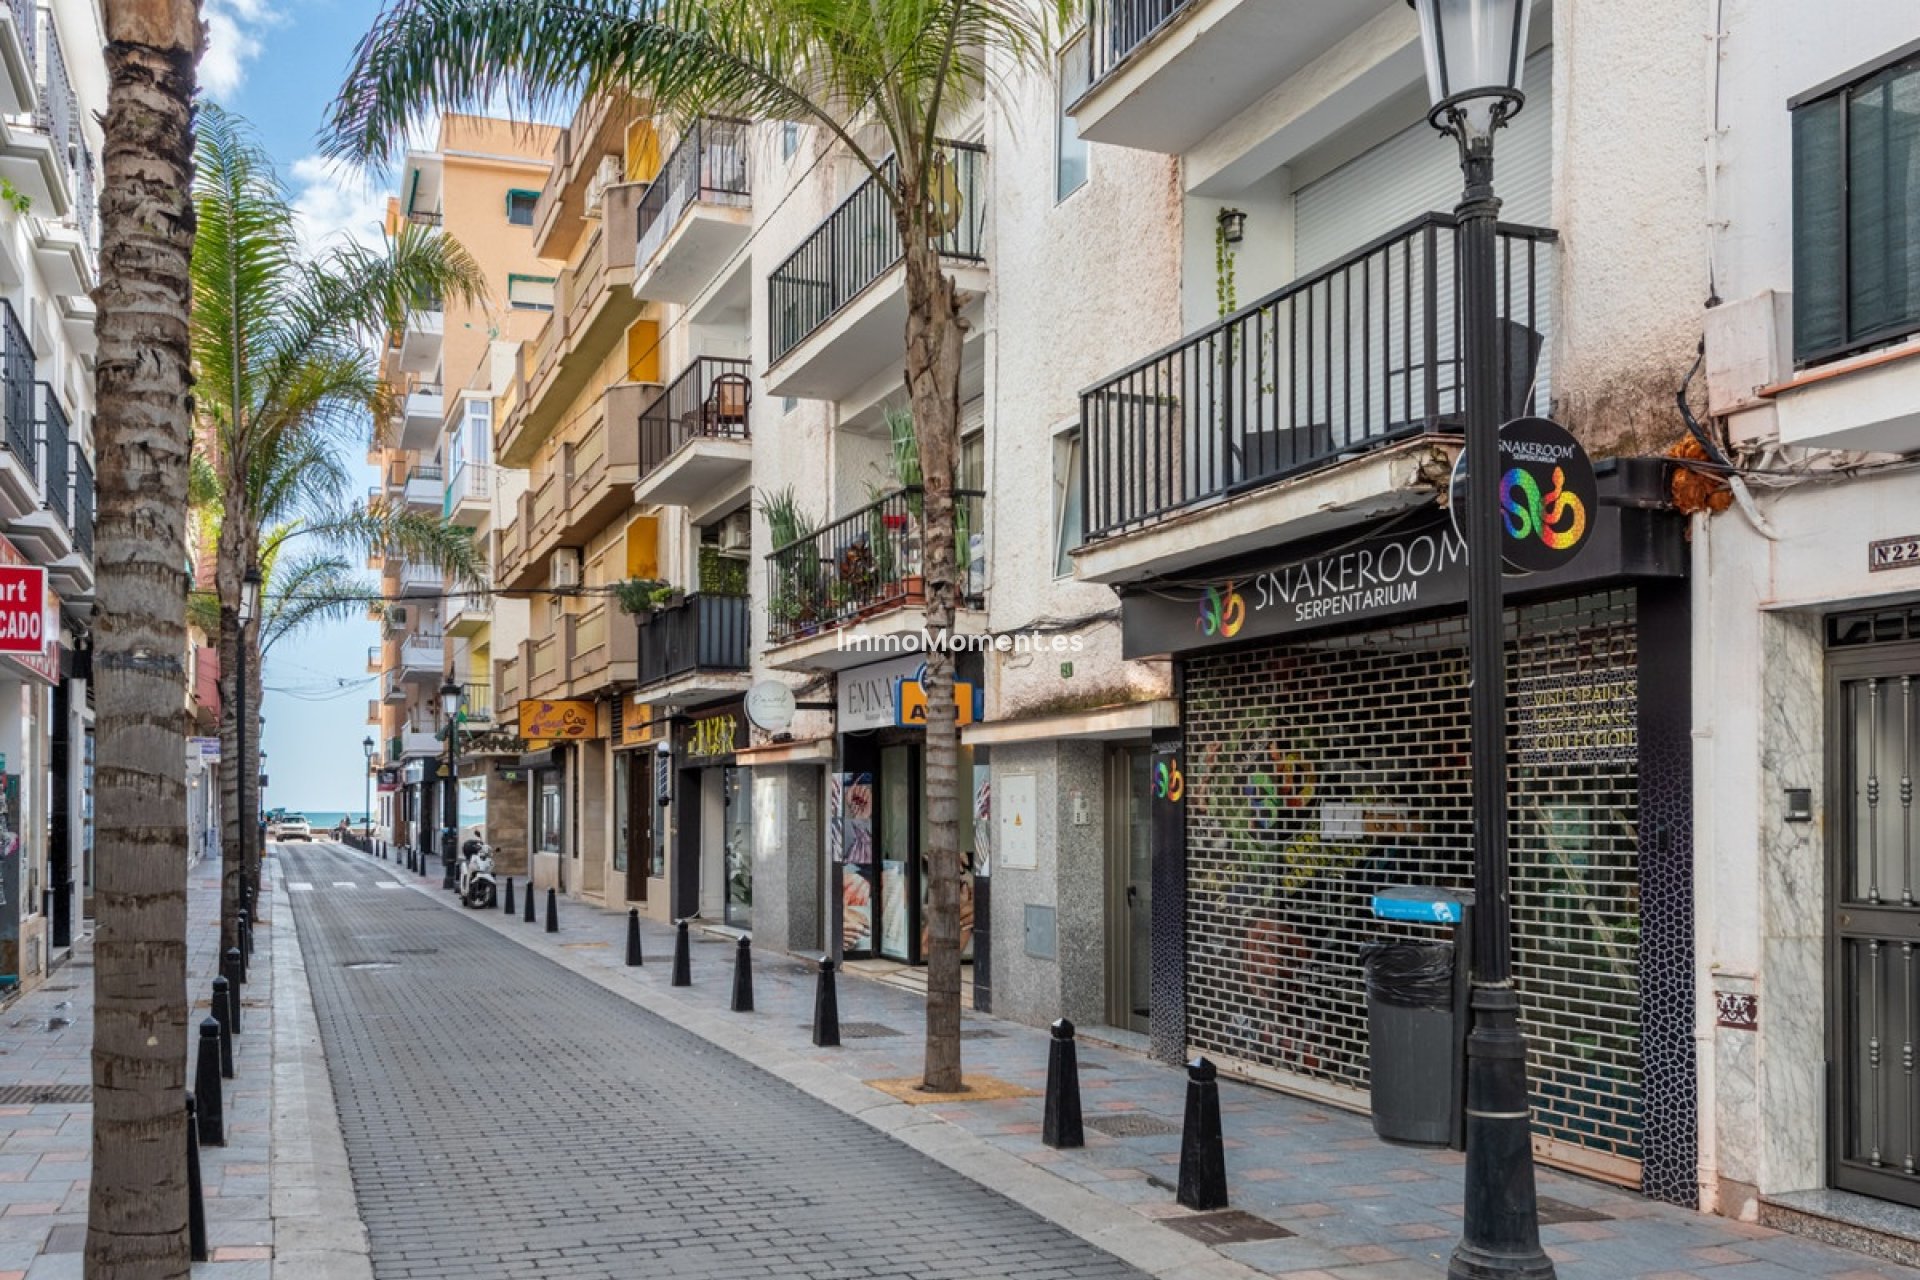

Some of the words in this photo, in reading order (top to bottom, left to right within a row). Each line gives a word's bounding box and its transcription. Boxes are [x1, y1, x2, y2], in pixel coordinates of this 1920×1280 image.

[1256, 529, 1469, 610] SNAKEROOM
[1296, 581, 1417, 621] SERPENTARIUM
[1539, 711, 1573, 729] BEST
